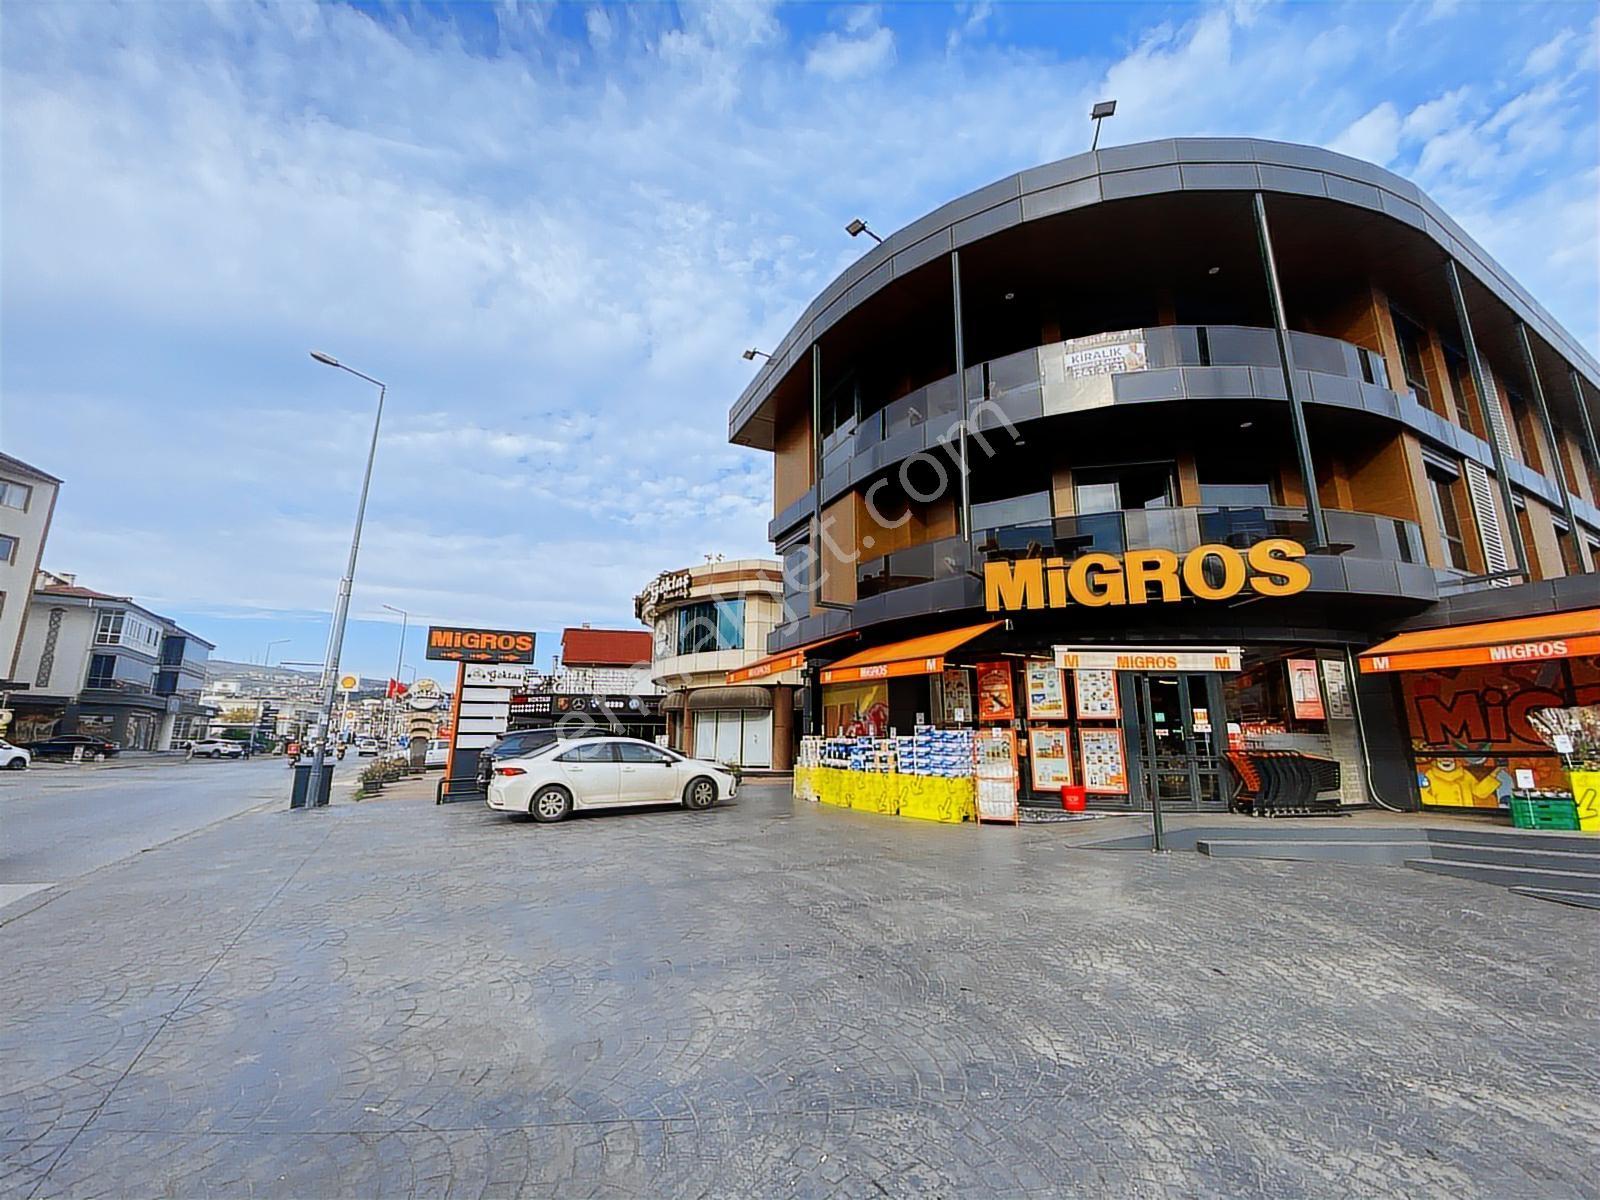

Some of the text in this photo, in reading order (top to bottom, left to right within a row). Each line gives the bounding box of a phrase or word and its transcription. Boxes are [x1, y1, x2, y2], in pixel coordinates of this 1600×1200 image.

[1071, 347, 1122, 364] KIRALIK
[984, 538, 1312, 612] MiGROS
[431, 630, 534, 652] MiGROS
[1063, 654, 1079, 668] M
[1116, 655, 1178, 669] MIGROS
[1214, 655, 1231, 670] M
[1372, 640, 1568, 671] M MIGROS
